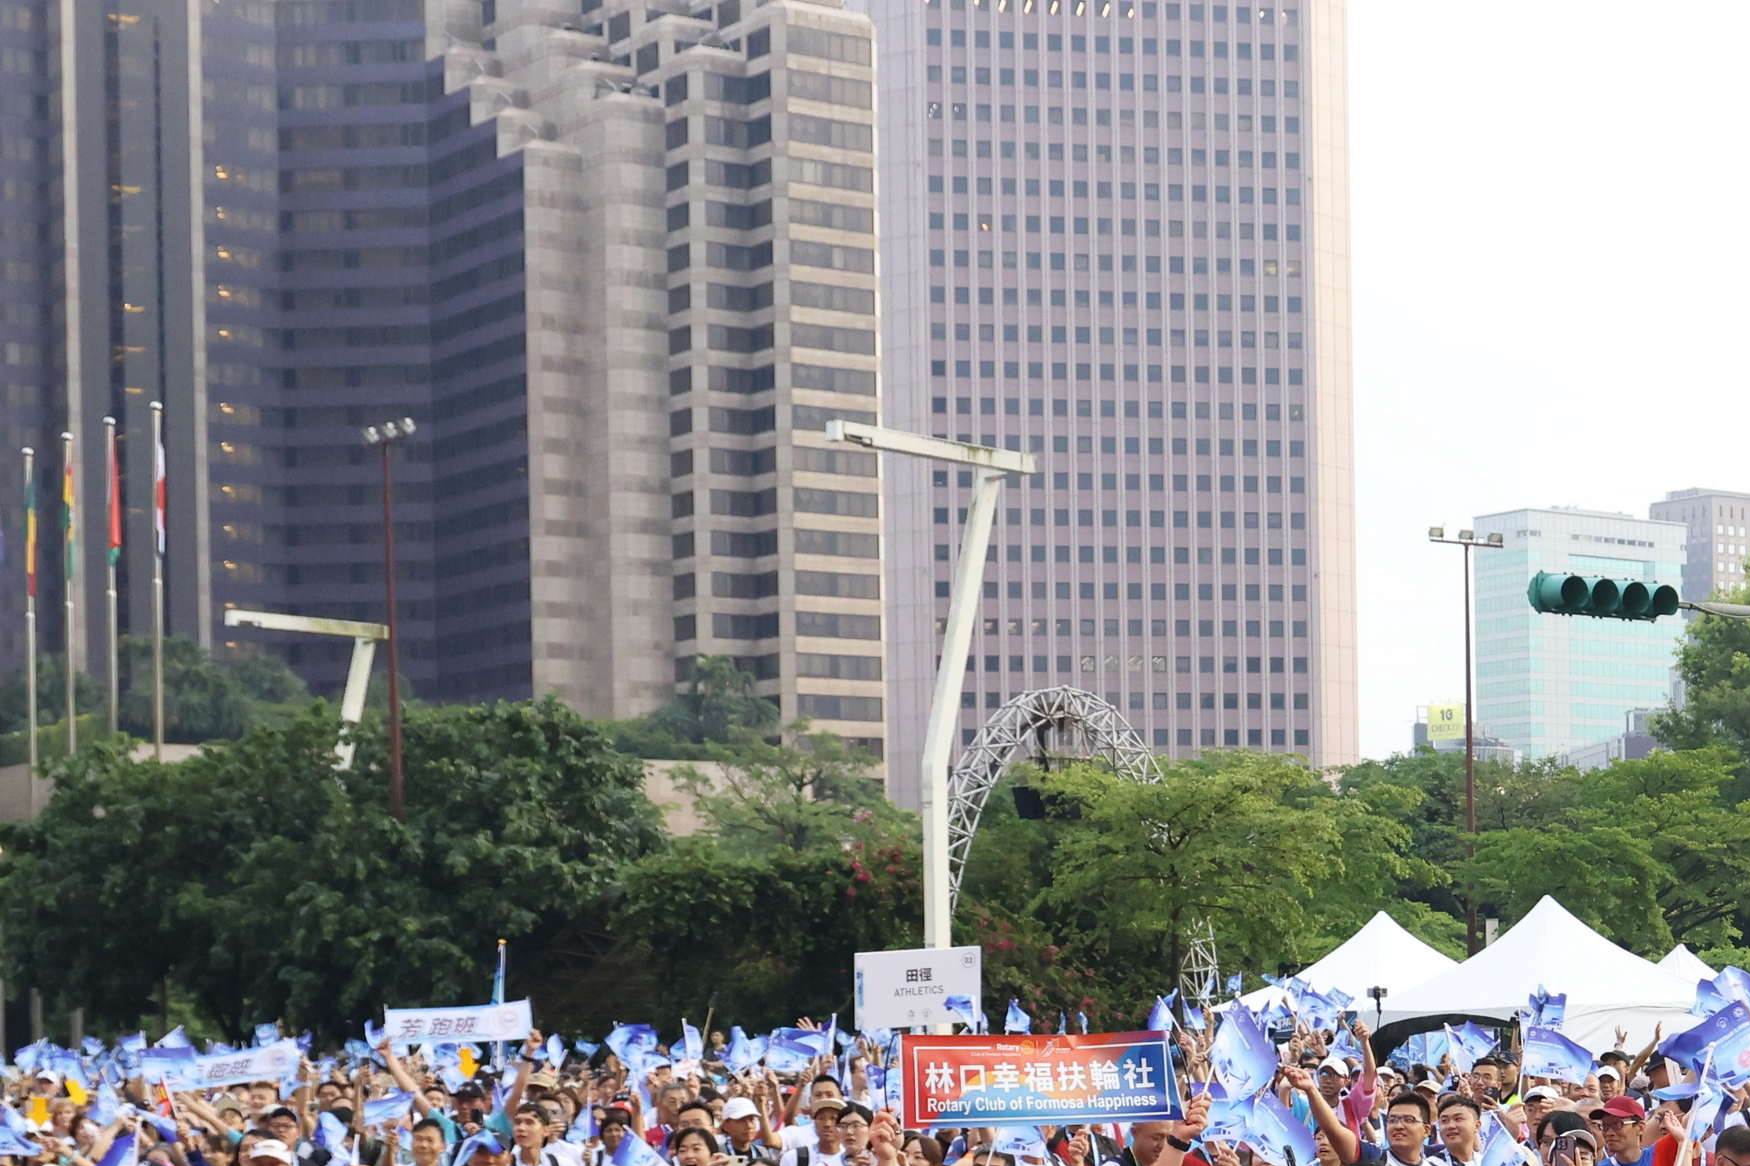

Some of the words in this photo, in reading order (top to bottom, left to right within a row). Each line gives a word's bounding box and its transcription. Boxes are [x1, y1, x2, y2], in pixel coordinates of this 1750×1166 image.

[906, 967, 932, 983] 田徑
[894, 984, 944, 998] ATHLETICS
[924, 1057, 1156, 1095] 林口幸福扶輪社
[927, 1097, 972, 1116] Rotary
[975, 1096, 1006, 1112] Club
[1010, 1097, 1023, 1111] of
[1026, 1095, 1084, 1111] Formosa
[1087, 1092, 1158, 1111] Happiness
